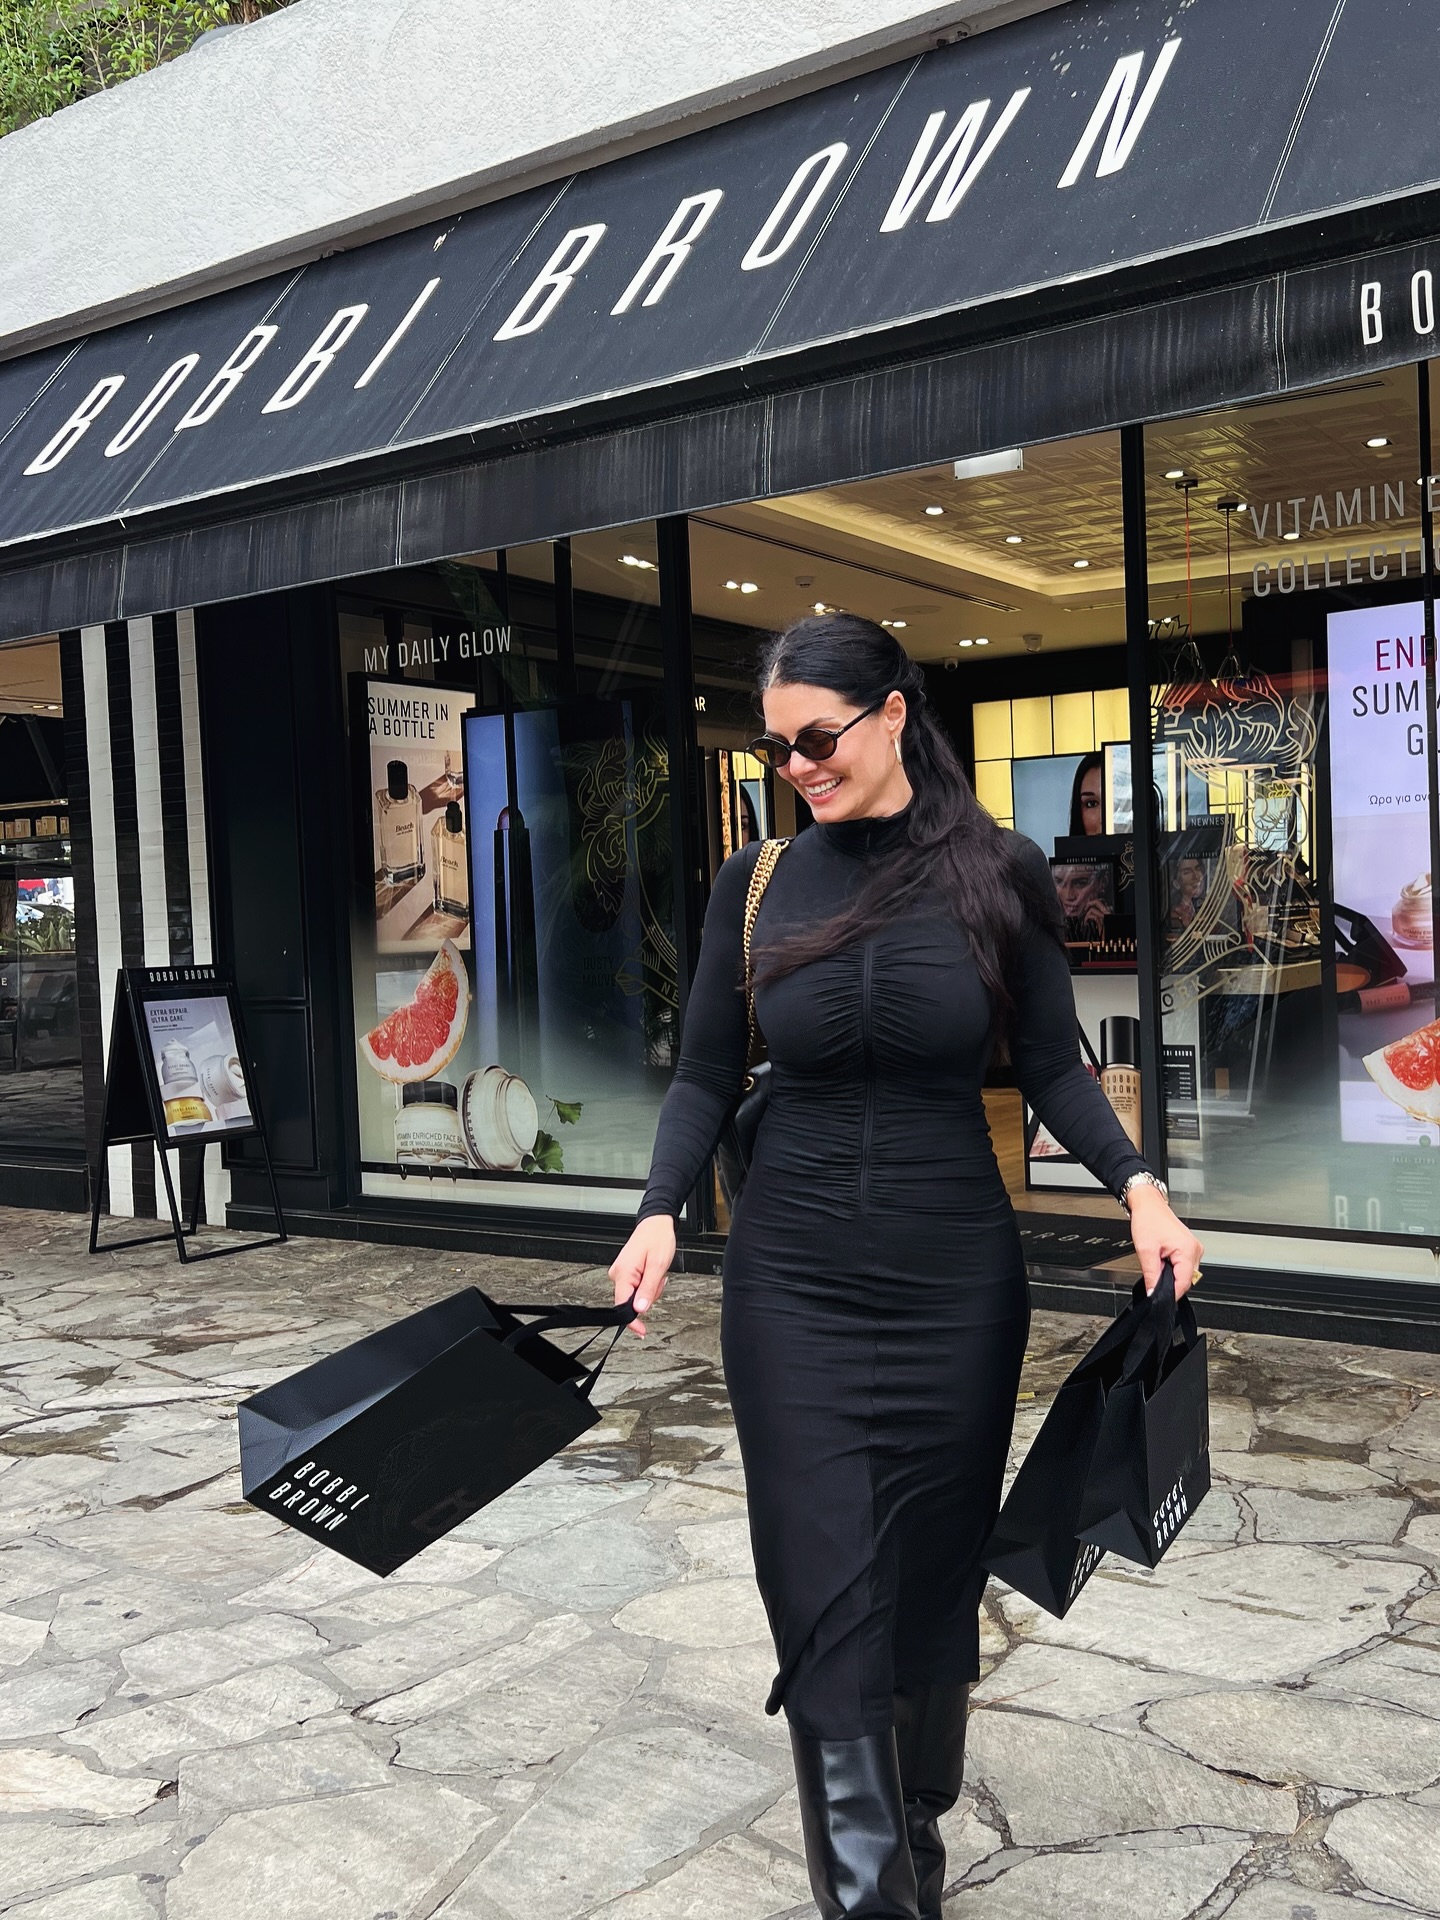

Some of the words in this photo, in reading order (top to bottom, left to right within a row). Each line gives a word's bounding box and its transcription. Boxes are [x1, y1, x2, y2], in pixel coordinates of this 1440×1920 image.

[23, 278, 441, 476] BOBBI
[494, 37, 1182, 341] BROWN
[1250, 480, 1404, 540] VITAMIN
[364, 645, 389, 672] MY
[398, 635, 450, 668] DAILY
[459, 625, 511, 659] GLOW
[368, 697, 430, 720] SUMMER
[435, 703, 449, 721] IN
[369, 717, 378, 736] A
[383, 718, 436, 740] BOTTLE
[149, 971, 179, 982] BOBBI
[184, 969, 216, 981] BROWN
[150, 1008, 168, 1016] EXTRA
[1106, 1074, 1136, 1084] BOBBI
[1106, 1085, 1137, 1095] BROWN
[293, 1461, 370, 1511] BOBBI
[269, 1481, 348, 1531] BROWN
[1156, 1495, 1188, 1549] BROWN
